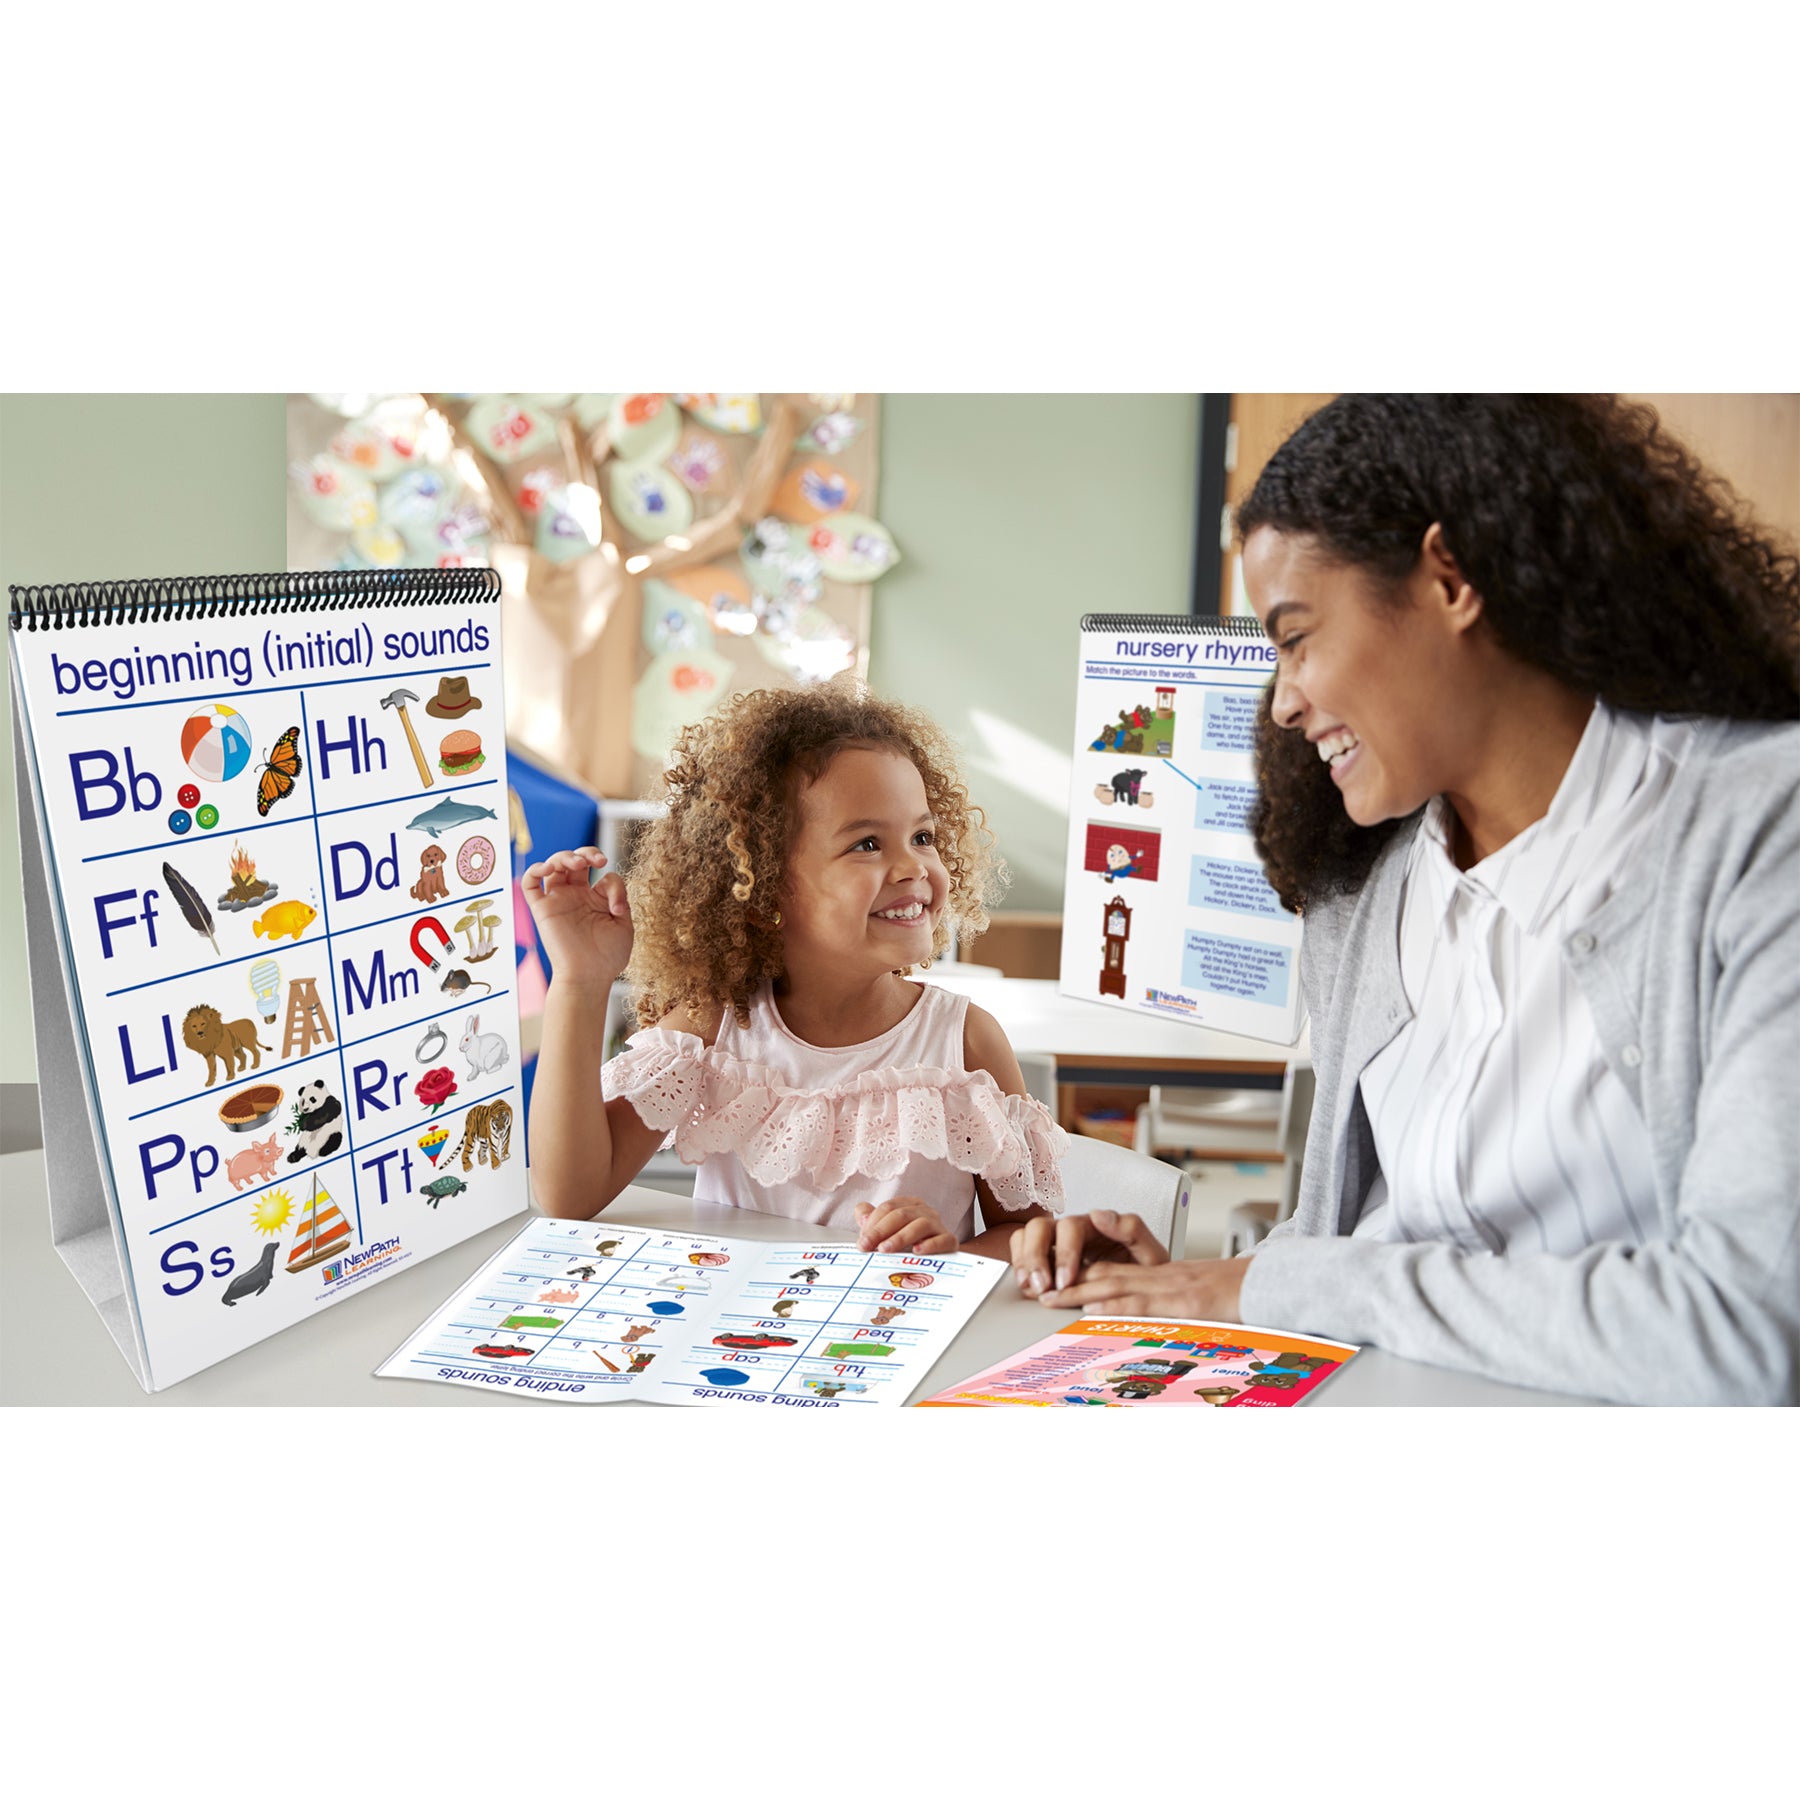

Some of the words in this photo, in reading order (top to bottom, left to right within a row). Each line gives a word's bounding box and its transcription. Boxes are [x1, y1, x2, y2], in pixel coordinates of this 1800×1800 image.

[51, 647, 252, 700] beginning
[263, 623, 373, 678] (initial)
[384, 618, 490, 660] sounds
[1116, 640, 1199, 663] nursery
[1205, 640, 1278, 666] rhyme
[1086, 665, 1108, 674] Match
[1109, 666, 1121, 675] the
[1122, 667, 1148, 678] picture
[1149, 669, 1157, 677] to
[1158, 669, 1171, 678] the
[316, 715, 387, 780] Hh
[68, 746, 162, 821] Bb
[330, 832, 400, 902] Dd
[93, 888, 159, 959] Ff
[1187, 943, 1211, 954] Humpty
[1212, 947, 1237, 958] Dumpty
[1191, 936, 1216, 946] Humpty
[1217, 939, 1242, 951] Dumpty
[342, 949, 419, 1016] Mm
[117, 1014, 178, 1085] Ll
[353, 1059, 408, 1121] Rr
[138, 1134, 219, 1201] Pp
[361, 1147, 413, 1205] Tt
[802, 1252, 840, 1265] hen
[902, 1257, 946, 1273] ham
[159, 1240, 236, 1297] Ss
[777, 1287, 811, 1298] cat
[881, 1290, 919, 1307] dog
[752, 1320, 786, 1329] car
[1087, 1324, 1181, 1336] CHARTS
[852, 1328, 895, 1342] bed
[722, 1351, 760, 1364] cap
[437, 1367, 512, 1386] sounds
[512, 1367, 535, 1375] ending
[834, 1363, 866, 1378] tub
[1211, 1368, 1250, 1377] quiet
[514, 1376, 586, 1393] ending
[1069, 1385, 1104, 1393] loud
[692, 1387, 767, 1402] sounds
[772, 1394, 840, 1407] ending
